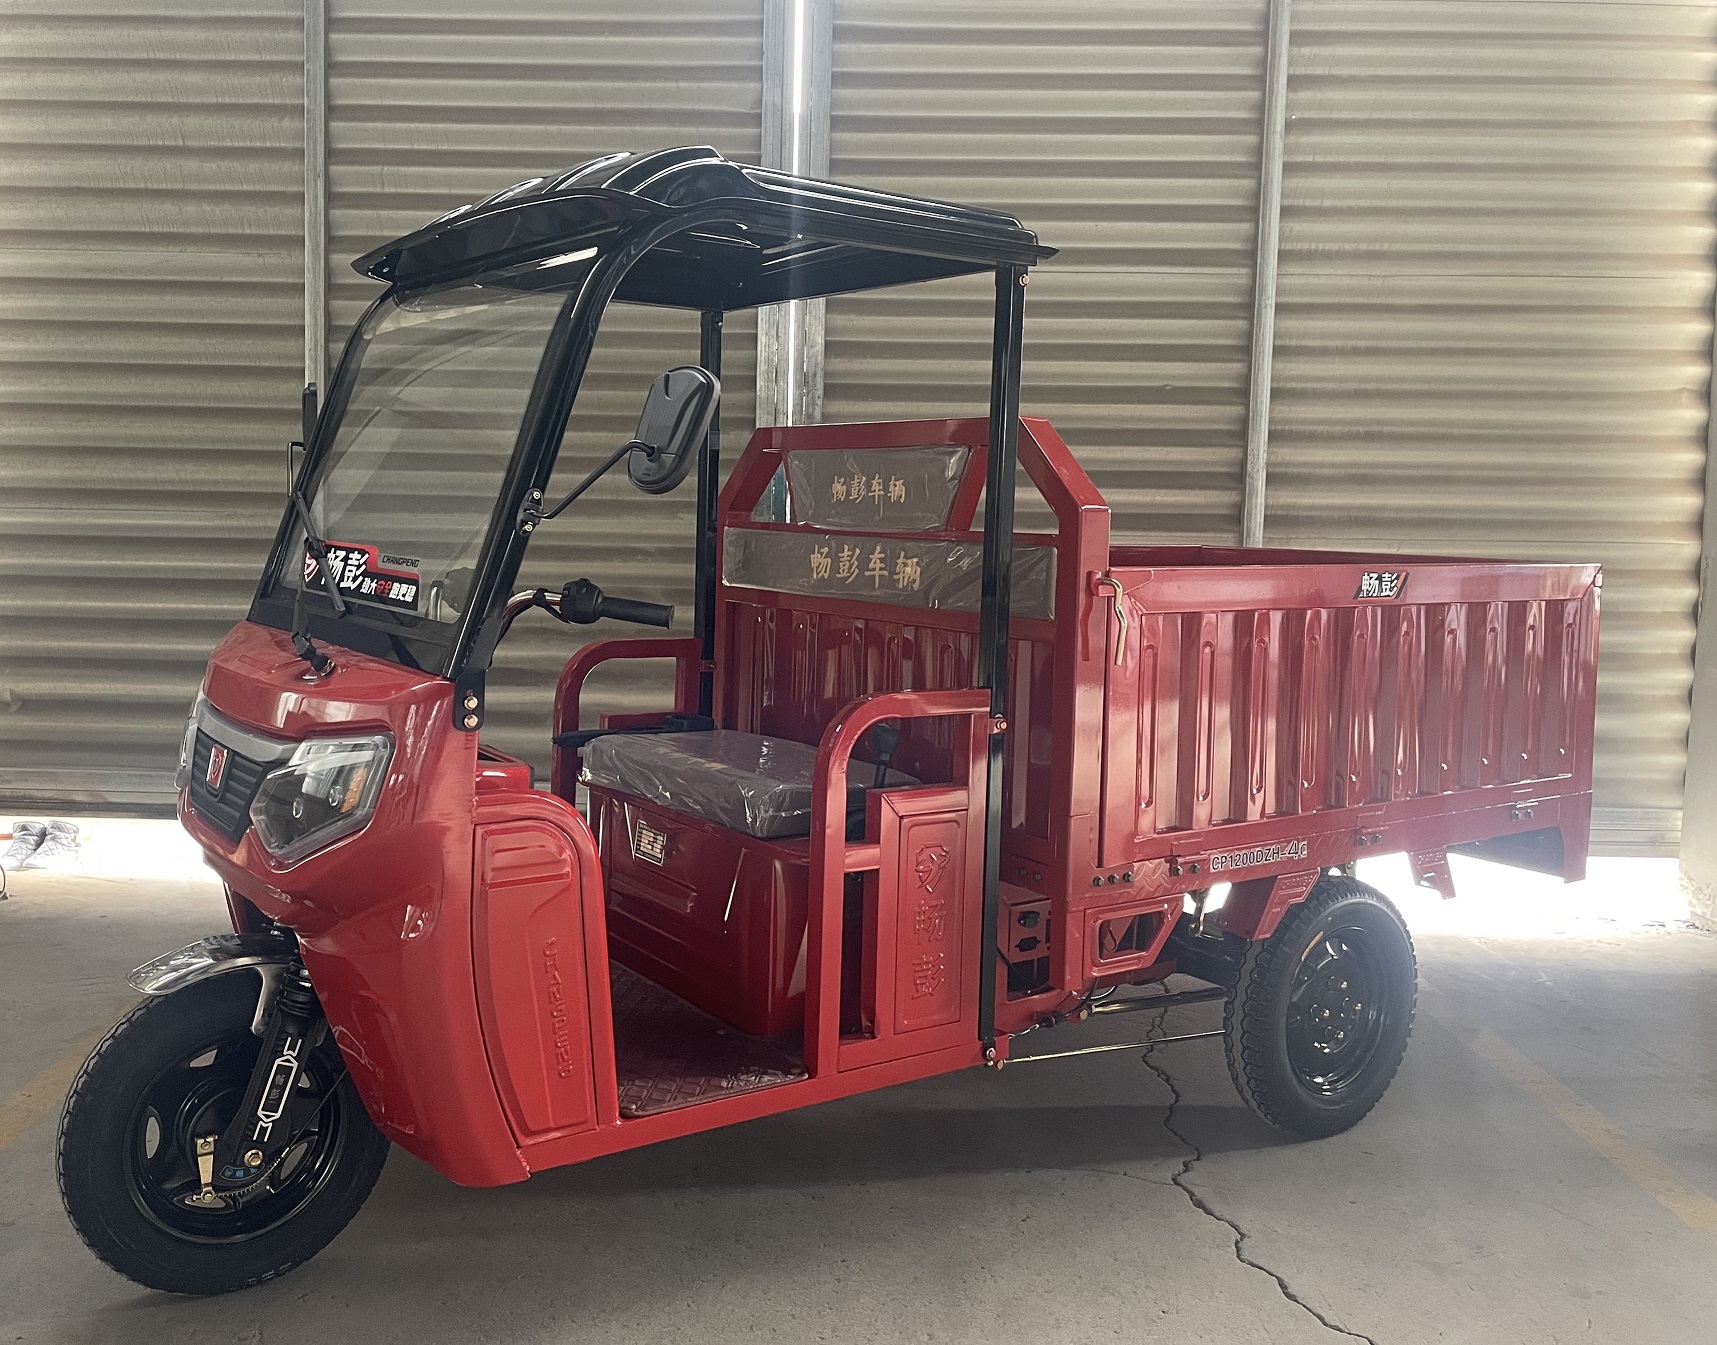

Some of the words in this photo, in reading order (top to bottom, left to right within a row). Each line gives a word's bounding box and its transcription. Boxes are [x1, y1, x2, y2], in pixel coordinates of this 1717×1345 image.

[832, 474, 906, 504] 畅彭车辆
[381, 555, 420, 568] CHANGPENG
[810, 544, 922, 591] 畅彭车辆
[1361, 572, 1398, 597] 畅彭
[911, 899, 947, 1001] 畅彭
